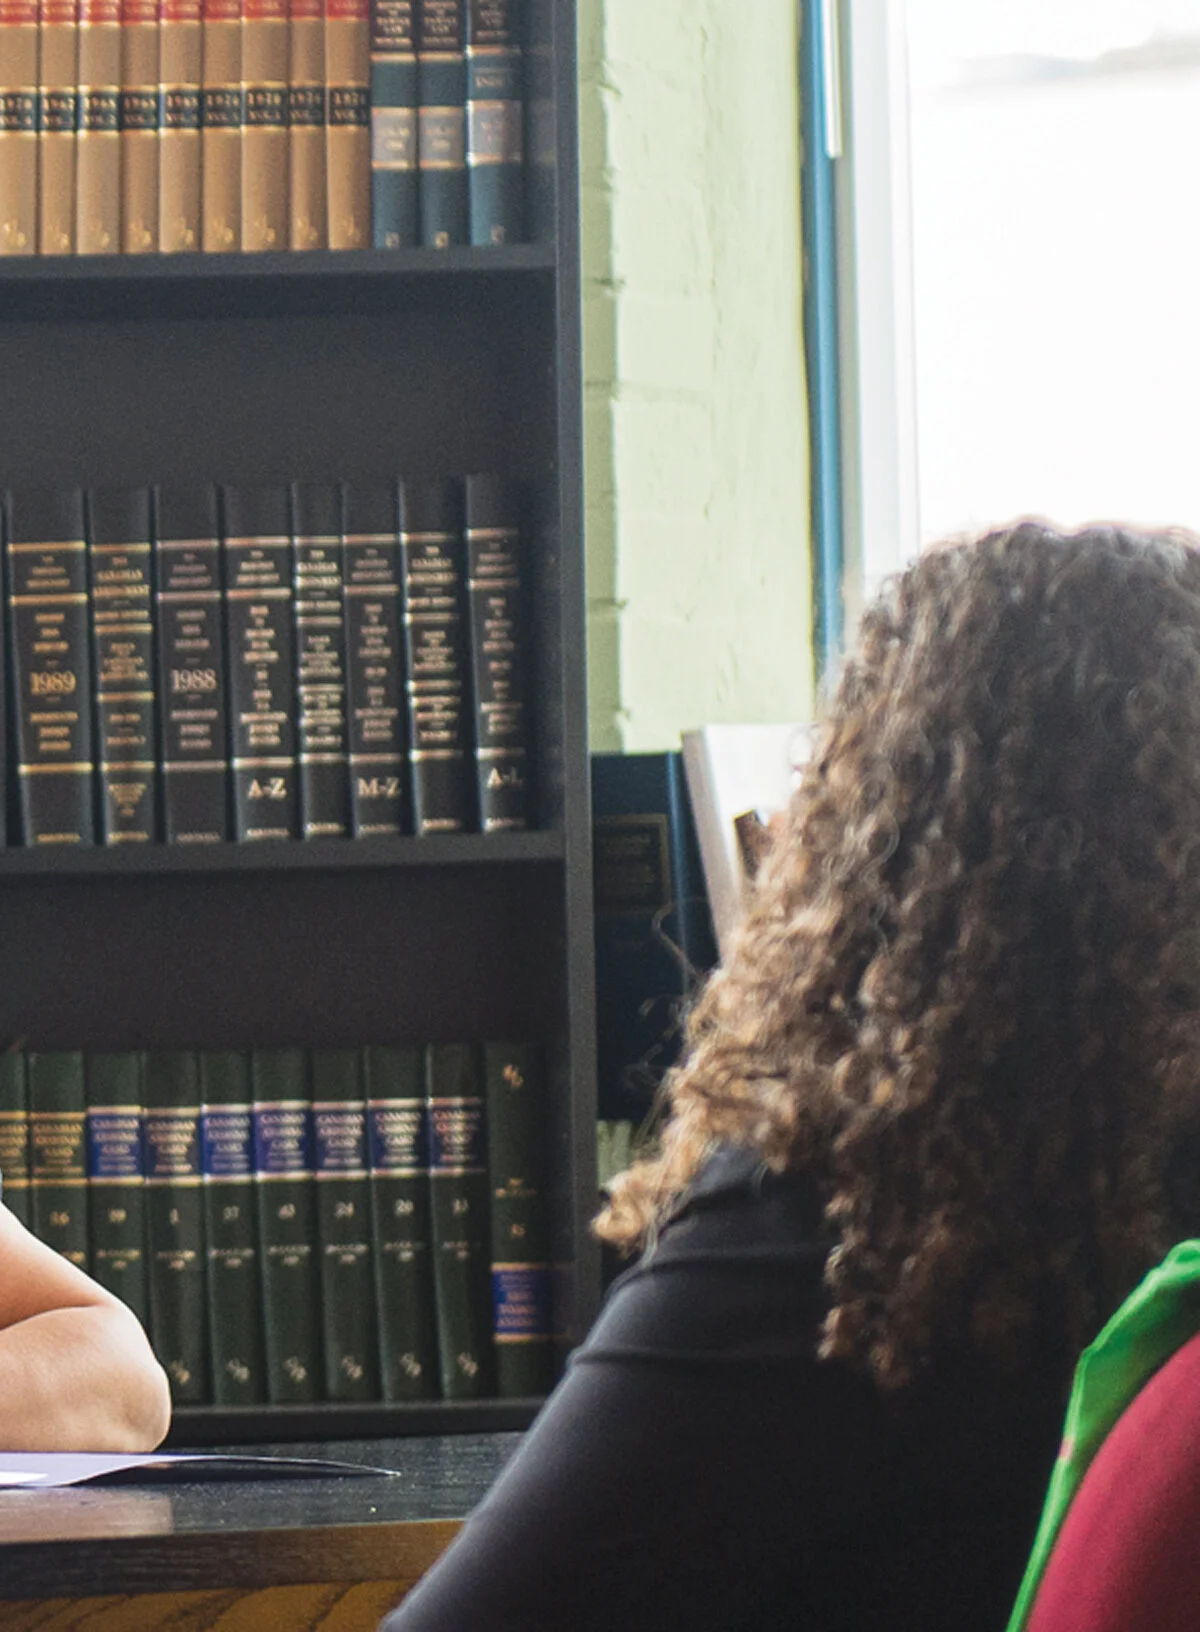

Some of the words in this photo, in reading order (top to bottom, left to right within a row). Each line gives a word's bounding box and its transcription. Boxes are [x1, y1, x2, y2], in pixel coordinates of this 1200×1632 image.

[30, 671, 76, 696] 1989
[171, 668, 216, 693] 1988
[248, 777, 287, 798] A-Z
[357, 777, 401, 798] M-Z
